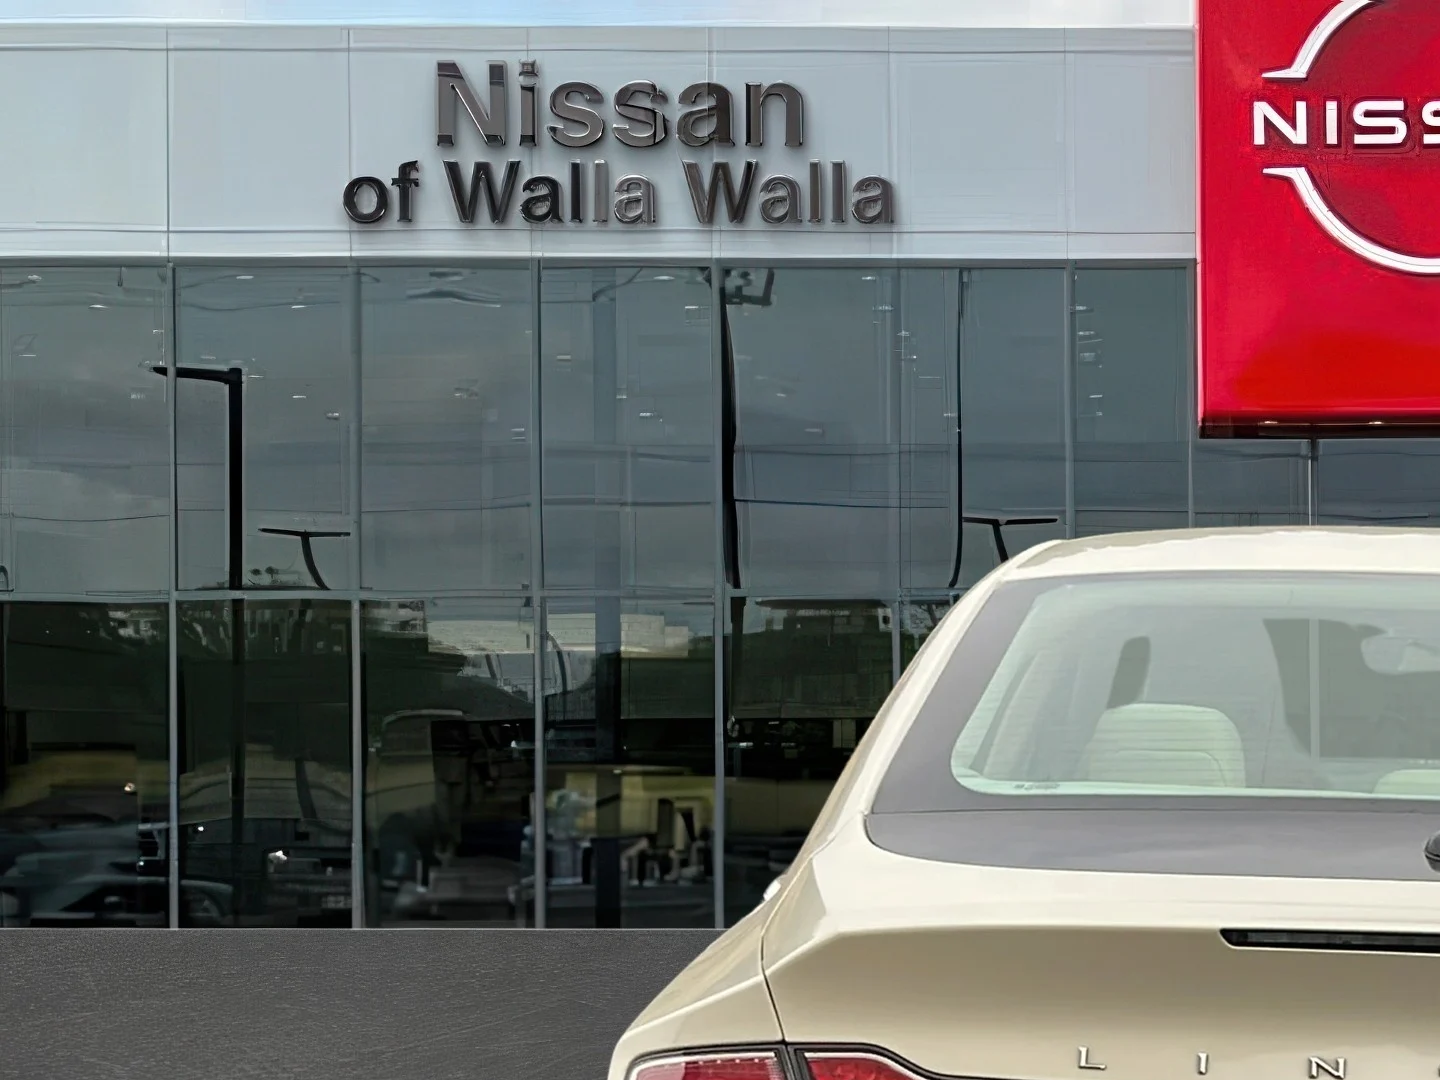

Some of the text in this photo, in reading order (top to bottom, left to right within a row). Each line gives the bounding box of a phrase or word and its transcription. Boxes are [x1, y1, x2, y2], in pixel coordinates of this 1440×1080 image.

[436, 59, 804, 147] Nissan
[342, 159, 895, 224] of Walla Walla
